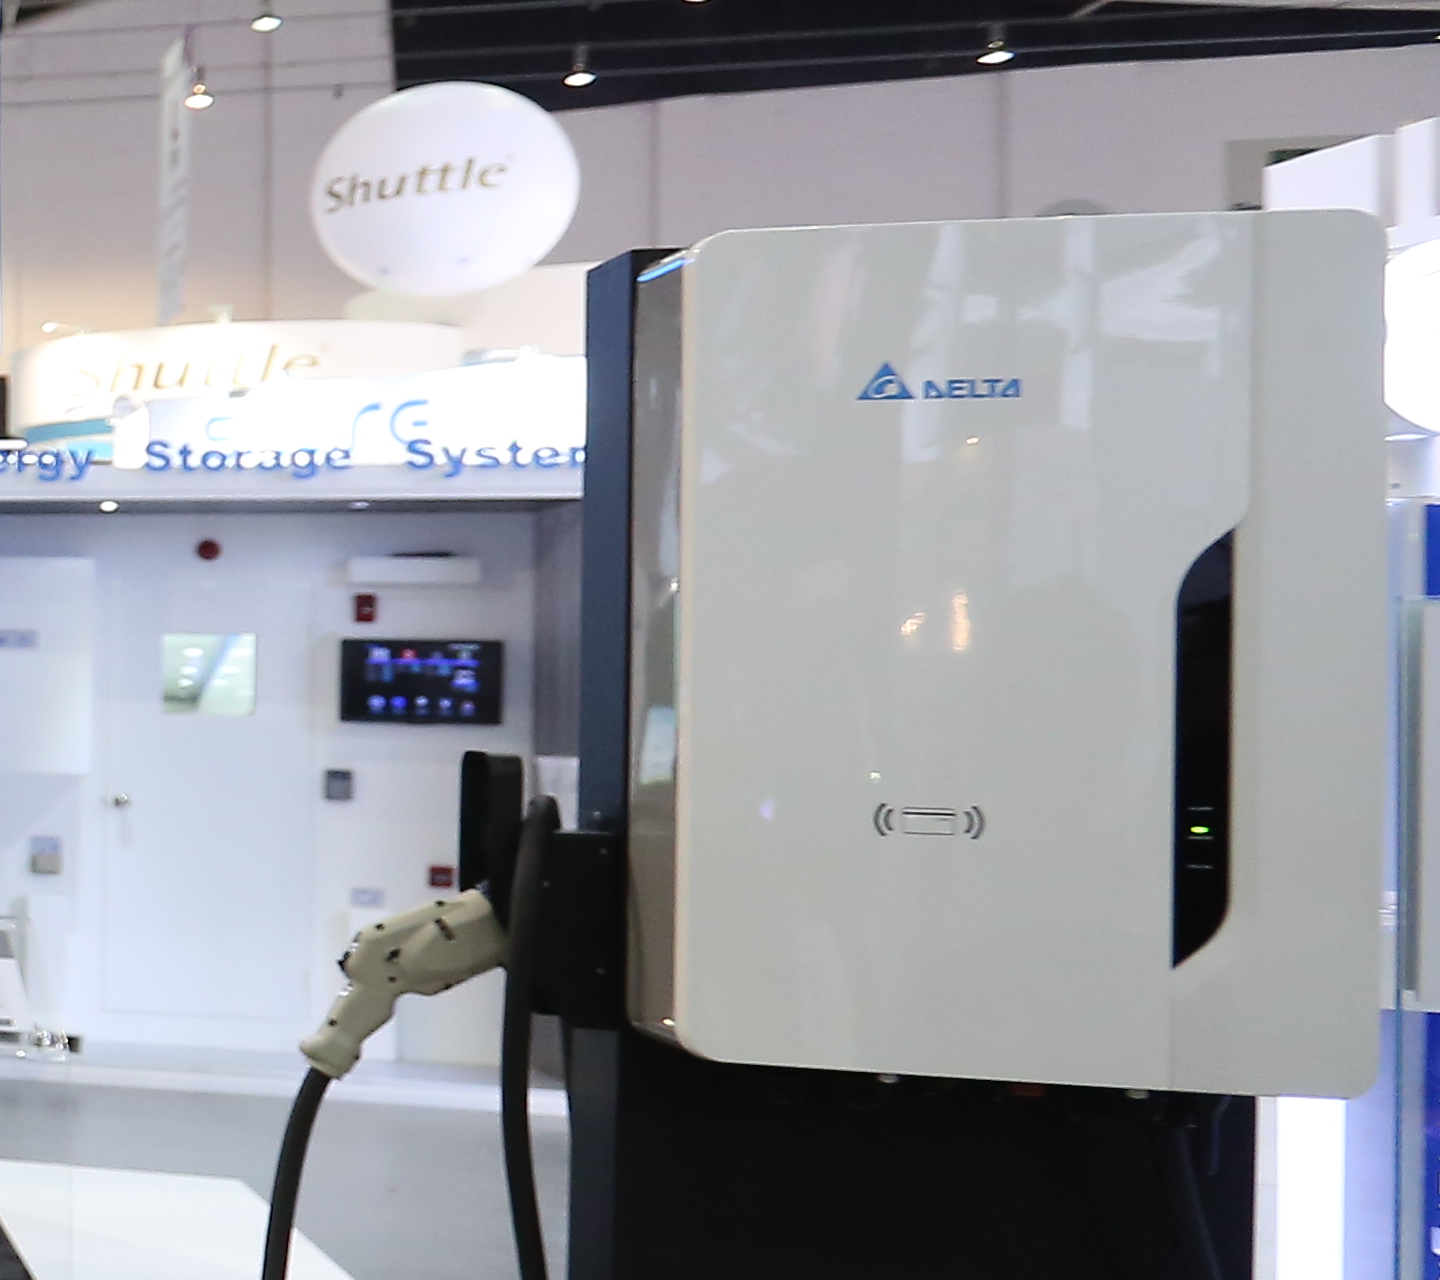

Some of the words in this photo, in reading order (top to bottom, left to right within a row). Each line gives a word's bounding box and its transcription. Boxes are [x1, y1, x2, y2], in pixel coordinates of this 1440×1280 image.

[323, 156, 509, 215] Shuttle
[920, 375, 1023, 400] DELTA
[143, 440, 352, 482] Storage
